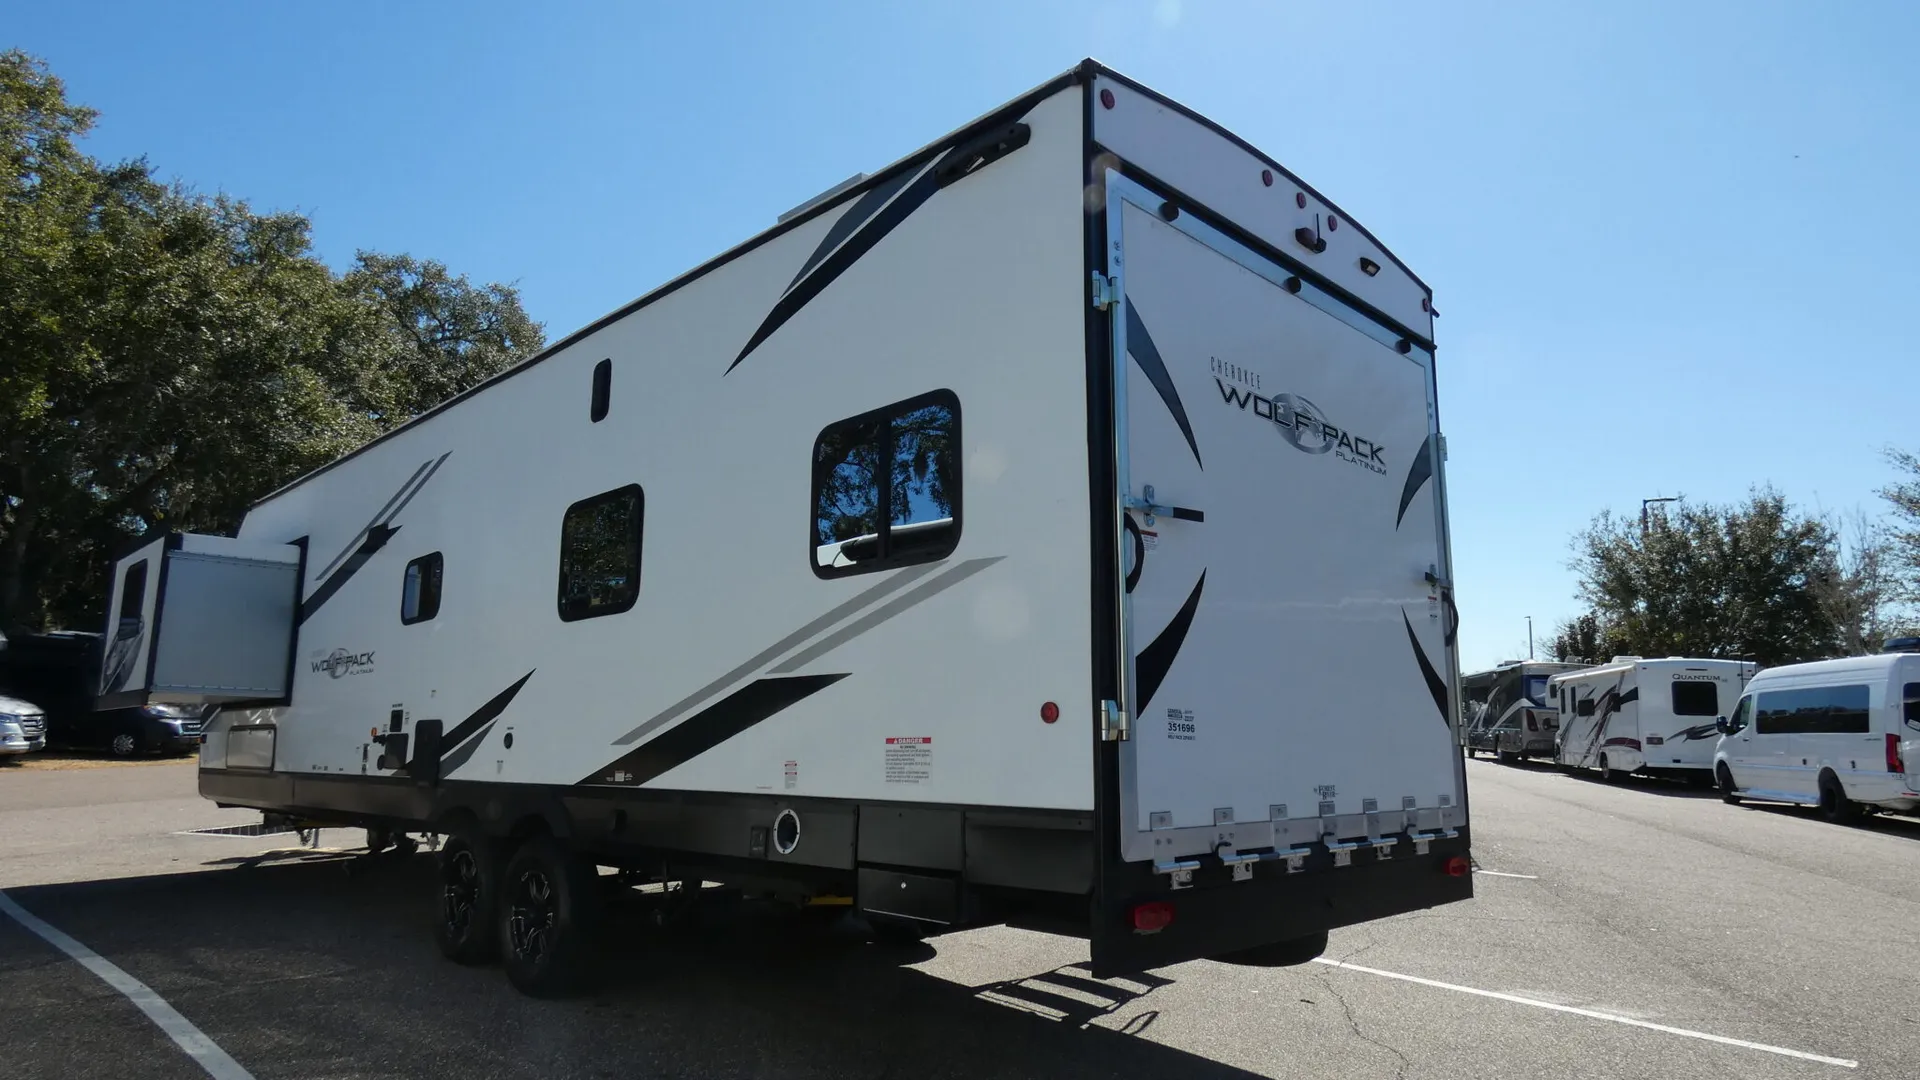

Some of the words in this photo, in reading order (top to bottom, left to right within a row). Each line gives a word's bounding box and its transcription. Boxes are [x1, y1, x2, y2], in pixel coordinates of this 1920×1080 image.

[1210, 355, 1261, 390] CHEROKEE
[1213, 375, 1313, 431] WOLF
[1321, 421, 1386, 466] PACK
[1335, 450, 1387, 477] PLATINUM
[344, 651, 375, 667] PACK
